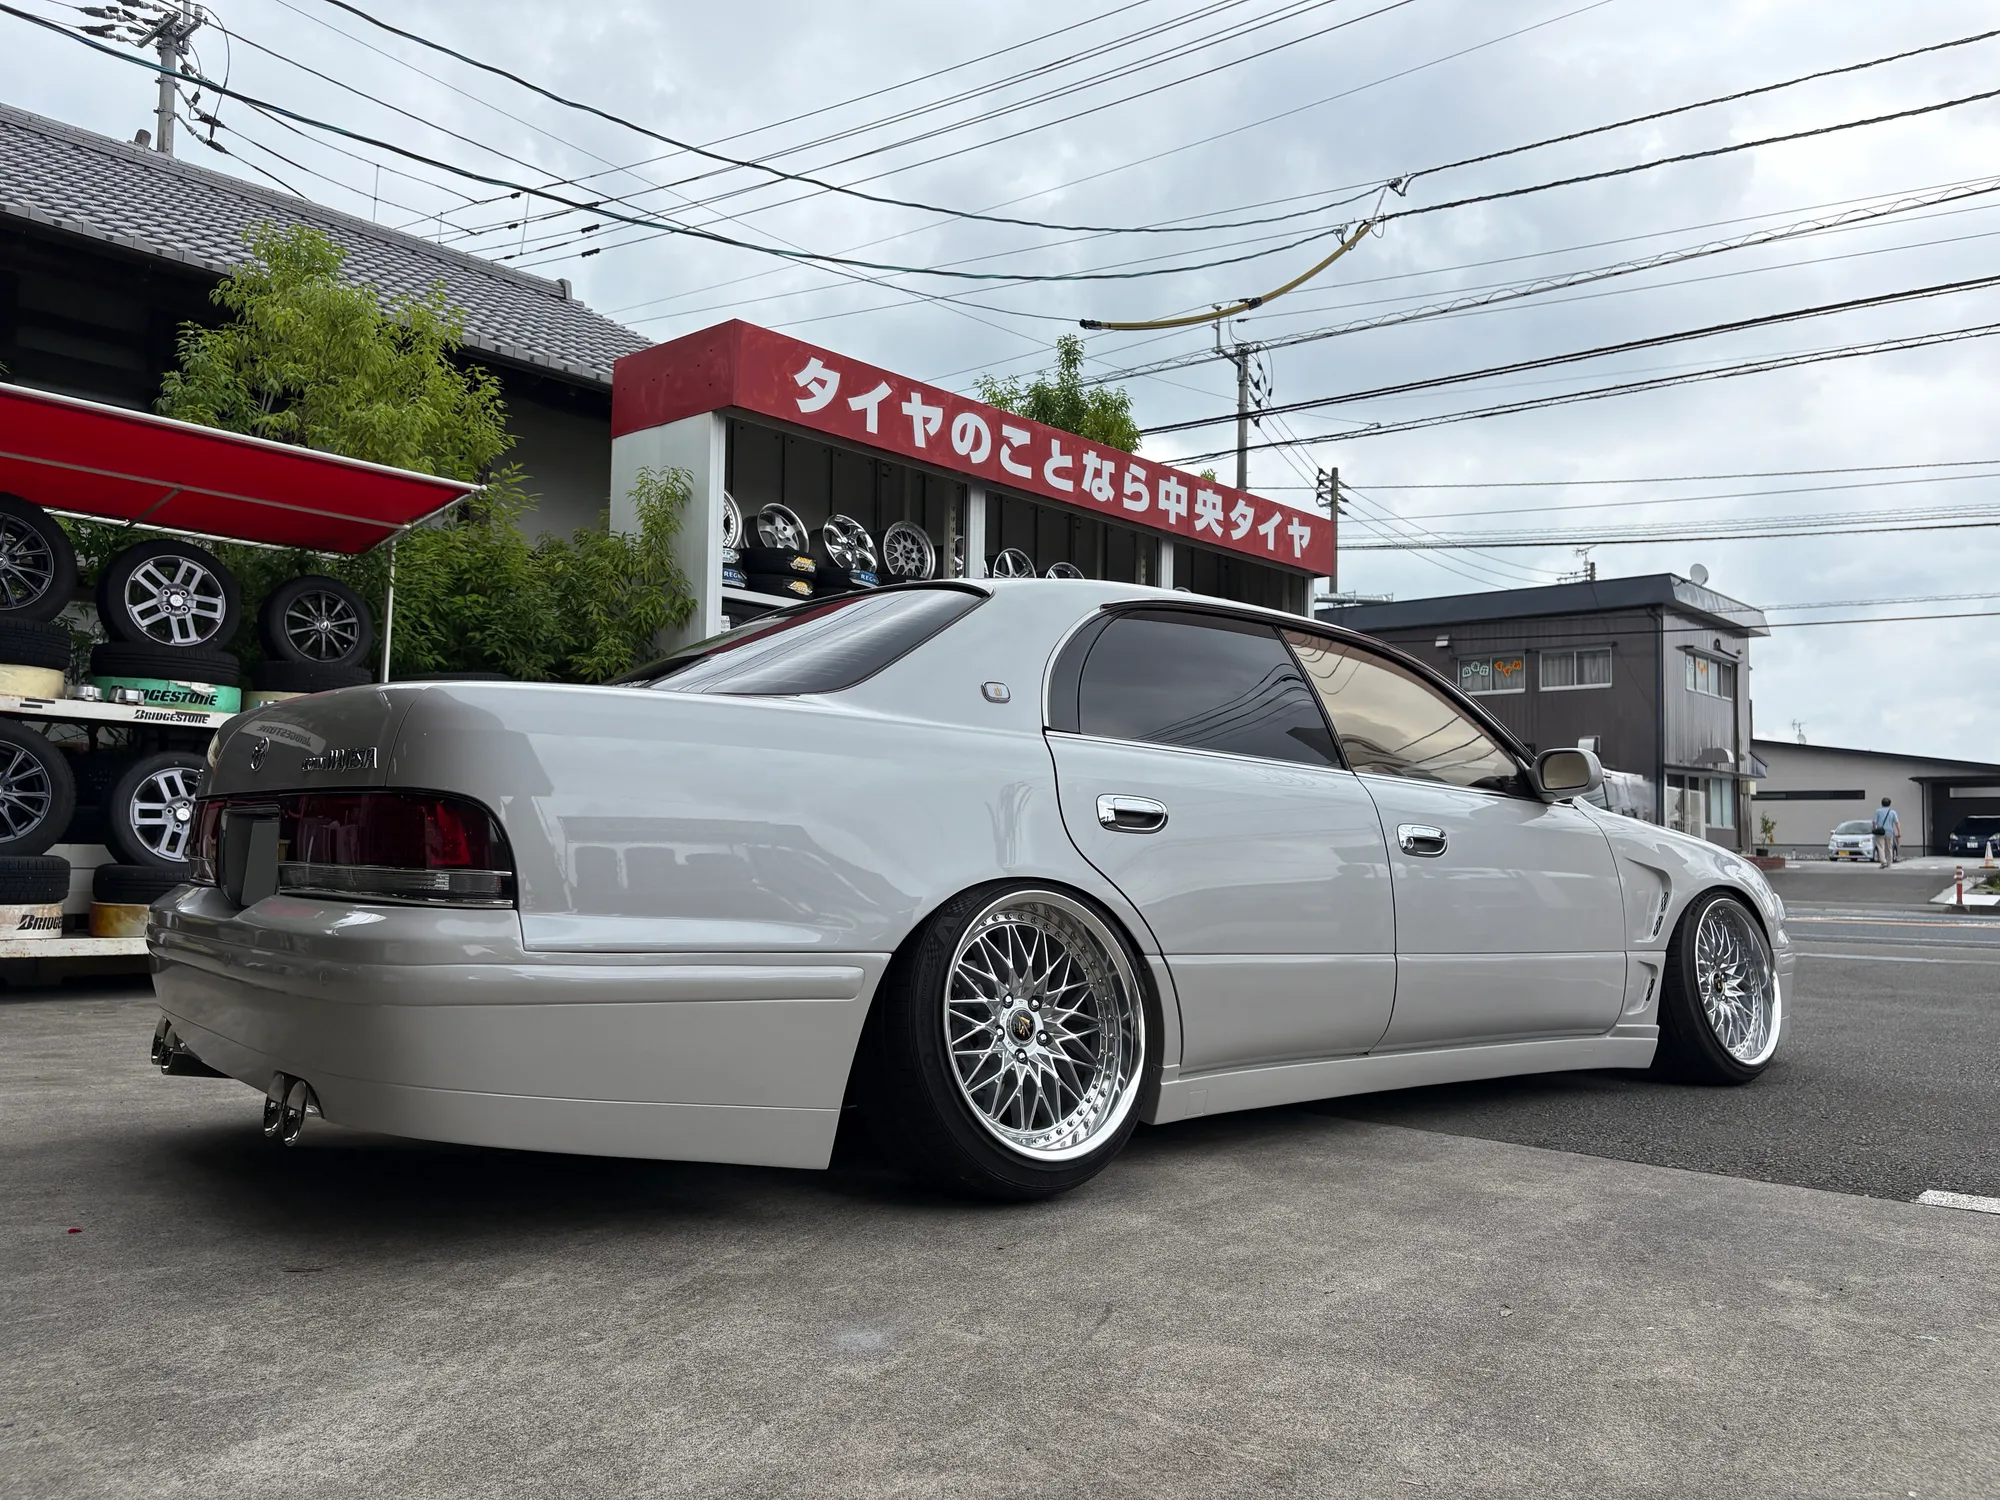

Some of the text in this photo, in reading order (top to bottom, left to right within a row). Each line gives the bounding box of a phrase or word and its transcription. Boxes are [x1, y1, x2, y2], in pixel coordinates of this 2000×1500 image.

[794, 356, 1311, 559] タイヤのことなら中央タイヤ
[133, 709, 208, 724] BRIDGESTONE
